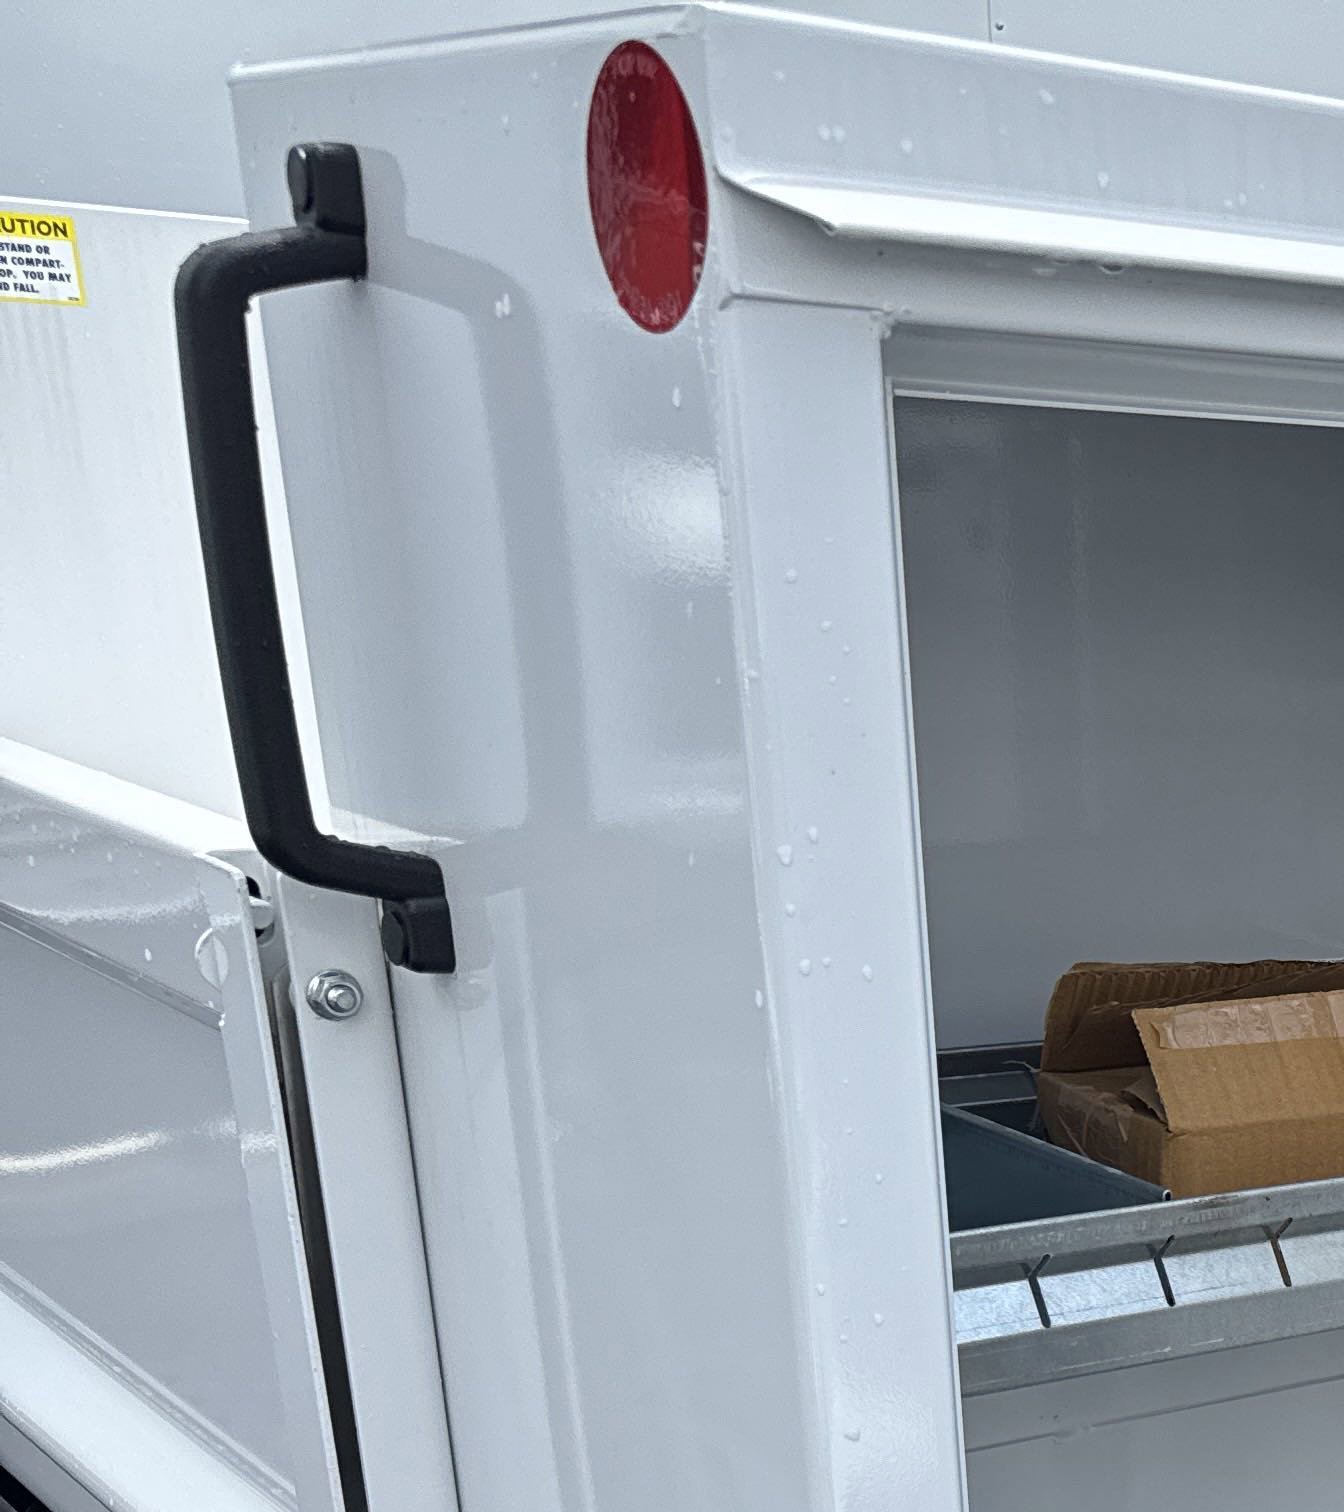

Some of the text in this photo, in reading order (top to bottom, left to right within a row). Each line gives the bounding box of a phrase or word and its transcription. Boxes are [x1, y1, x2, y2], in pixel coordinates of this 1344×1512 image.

[0, 216, 69, 238] UTION
[35, 245, 51, 255] OR
[11, 256, 65, 269] COMPART-
[0, 268, 72, 283] OP. YOU MAY
